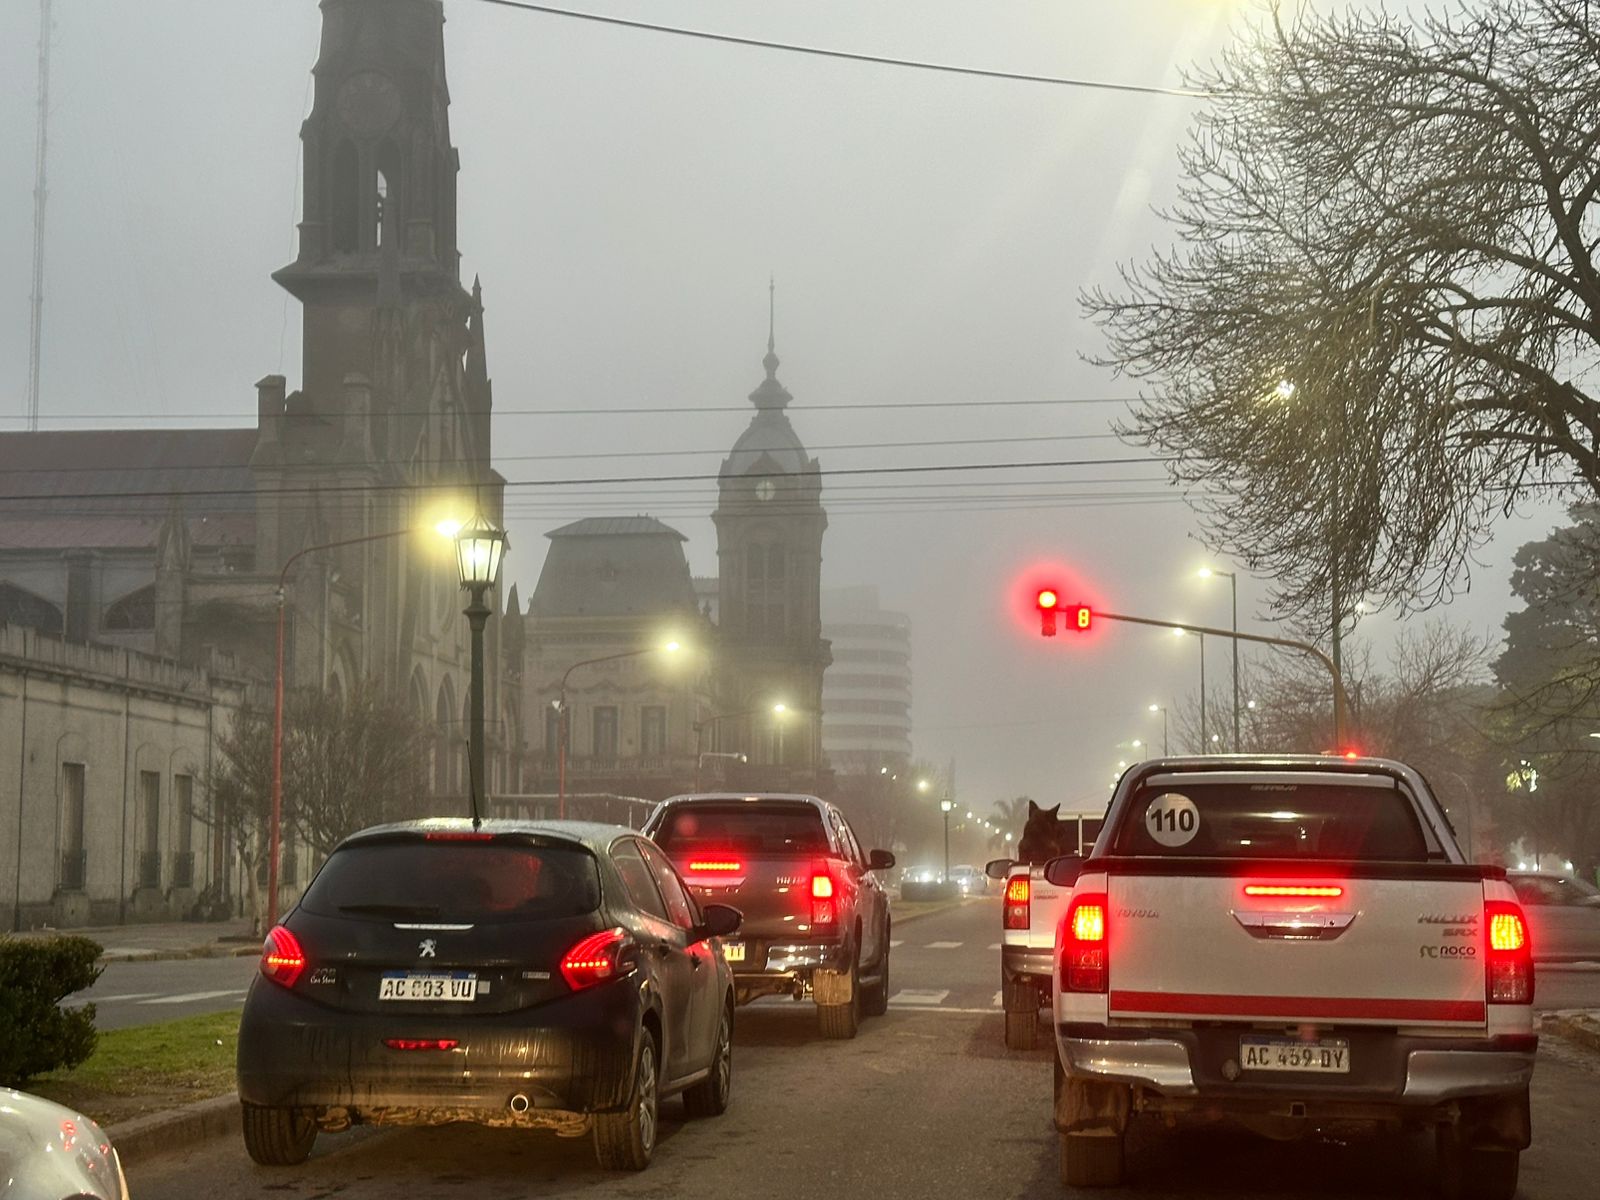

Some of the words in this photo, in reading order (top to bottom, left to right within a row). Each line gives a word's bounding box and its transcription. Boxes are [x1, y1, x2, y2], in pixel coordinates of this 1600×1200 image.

[1078, 608, 1089, 628] 8
[1151, 809, 1194, 832] 110
[383, 980, 405, 997] AC
[451, 980, 473, 998] VU
[1246, 1047, 1269, 1066] AC
[1320, 1049, 1343, 1069] DY
